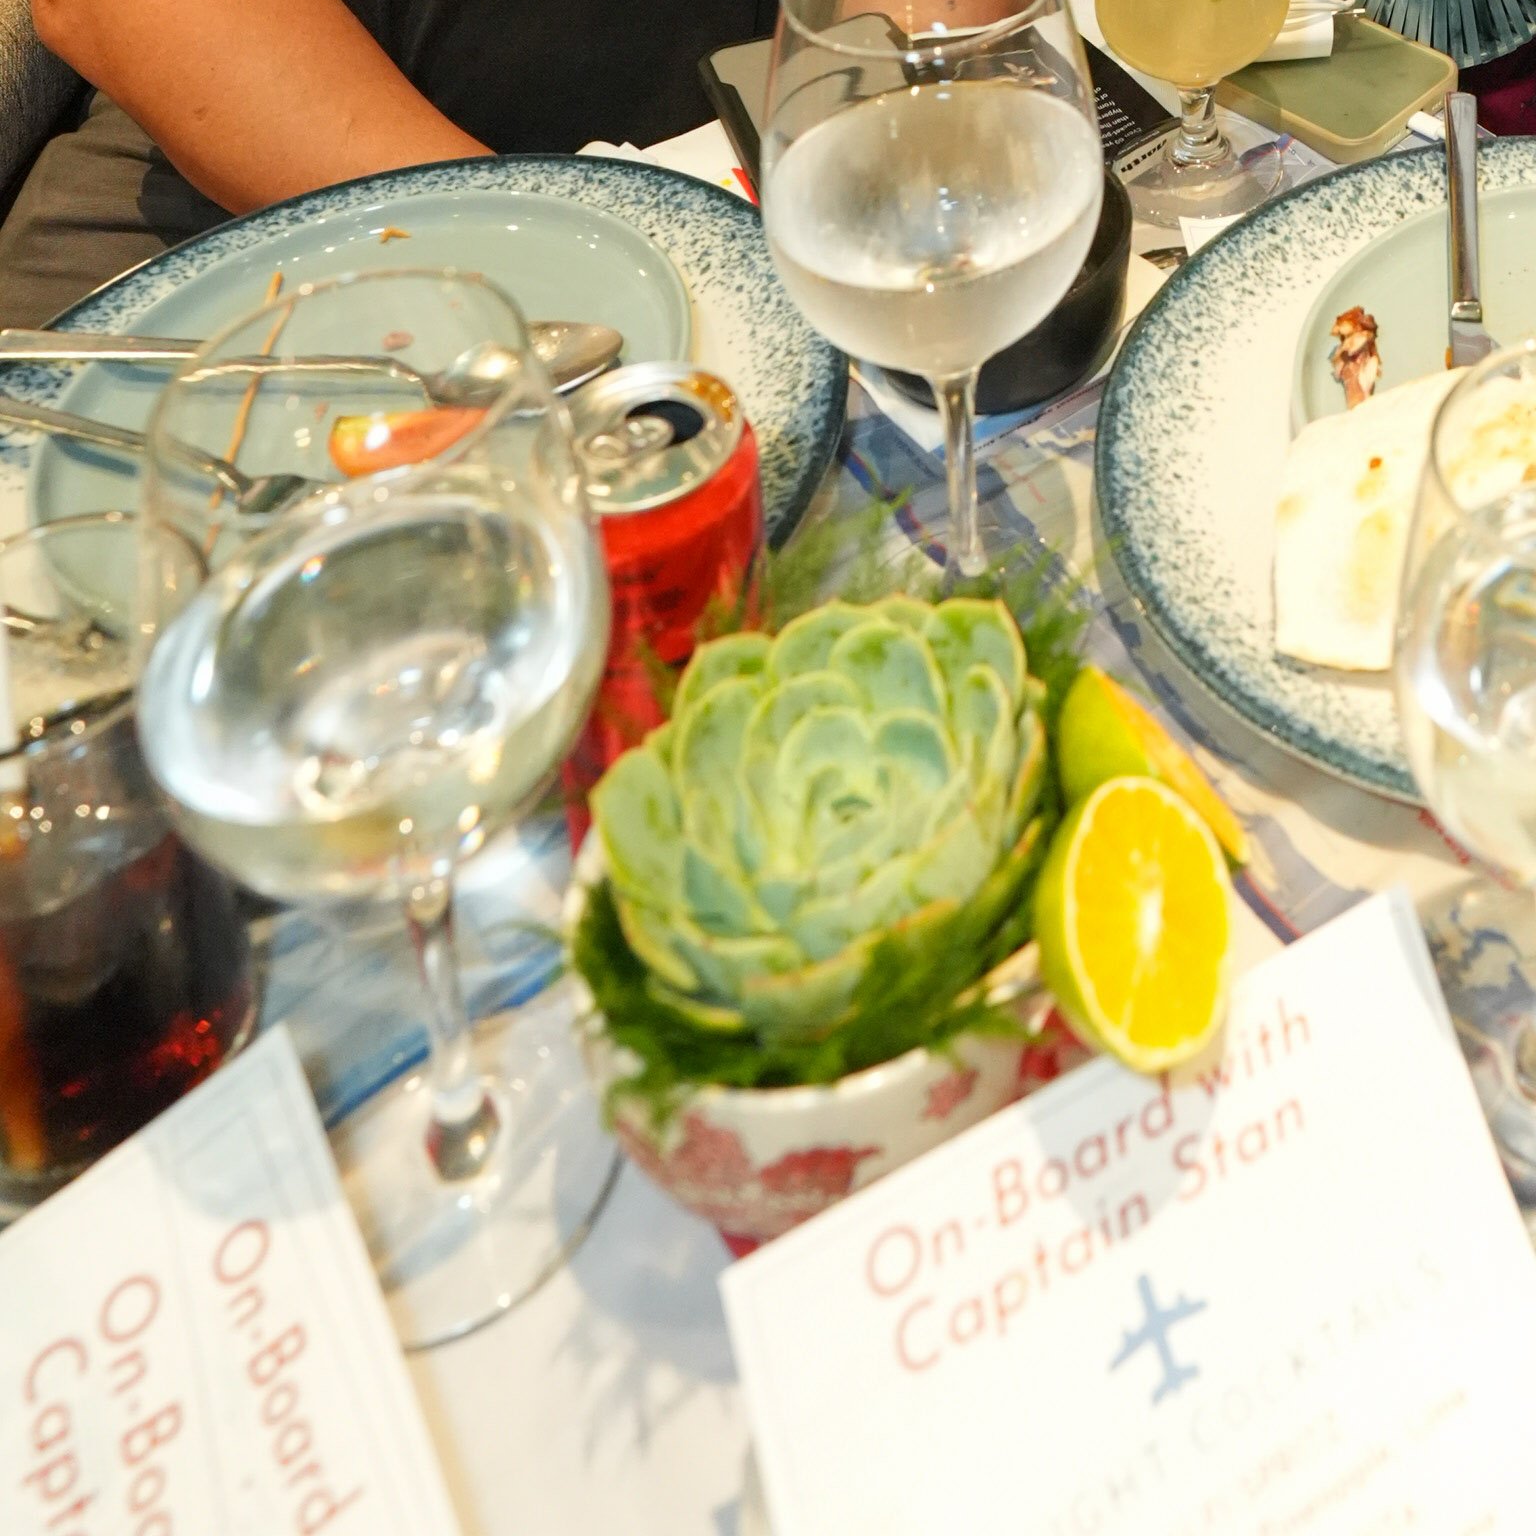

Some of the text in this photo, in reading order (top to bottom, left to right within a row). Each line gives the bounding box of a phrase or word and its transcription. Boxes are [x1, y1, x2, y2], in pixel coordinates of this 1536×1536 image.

[864, 996, 1312, 1299] On-Board with
[892, 1096, 1307, 1376] Captain Stan
[211, 1218, 366, 1536] On-Board
